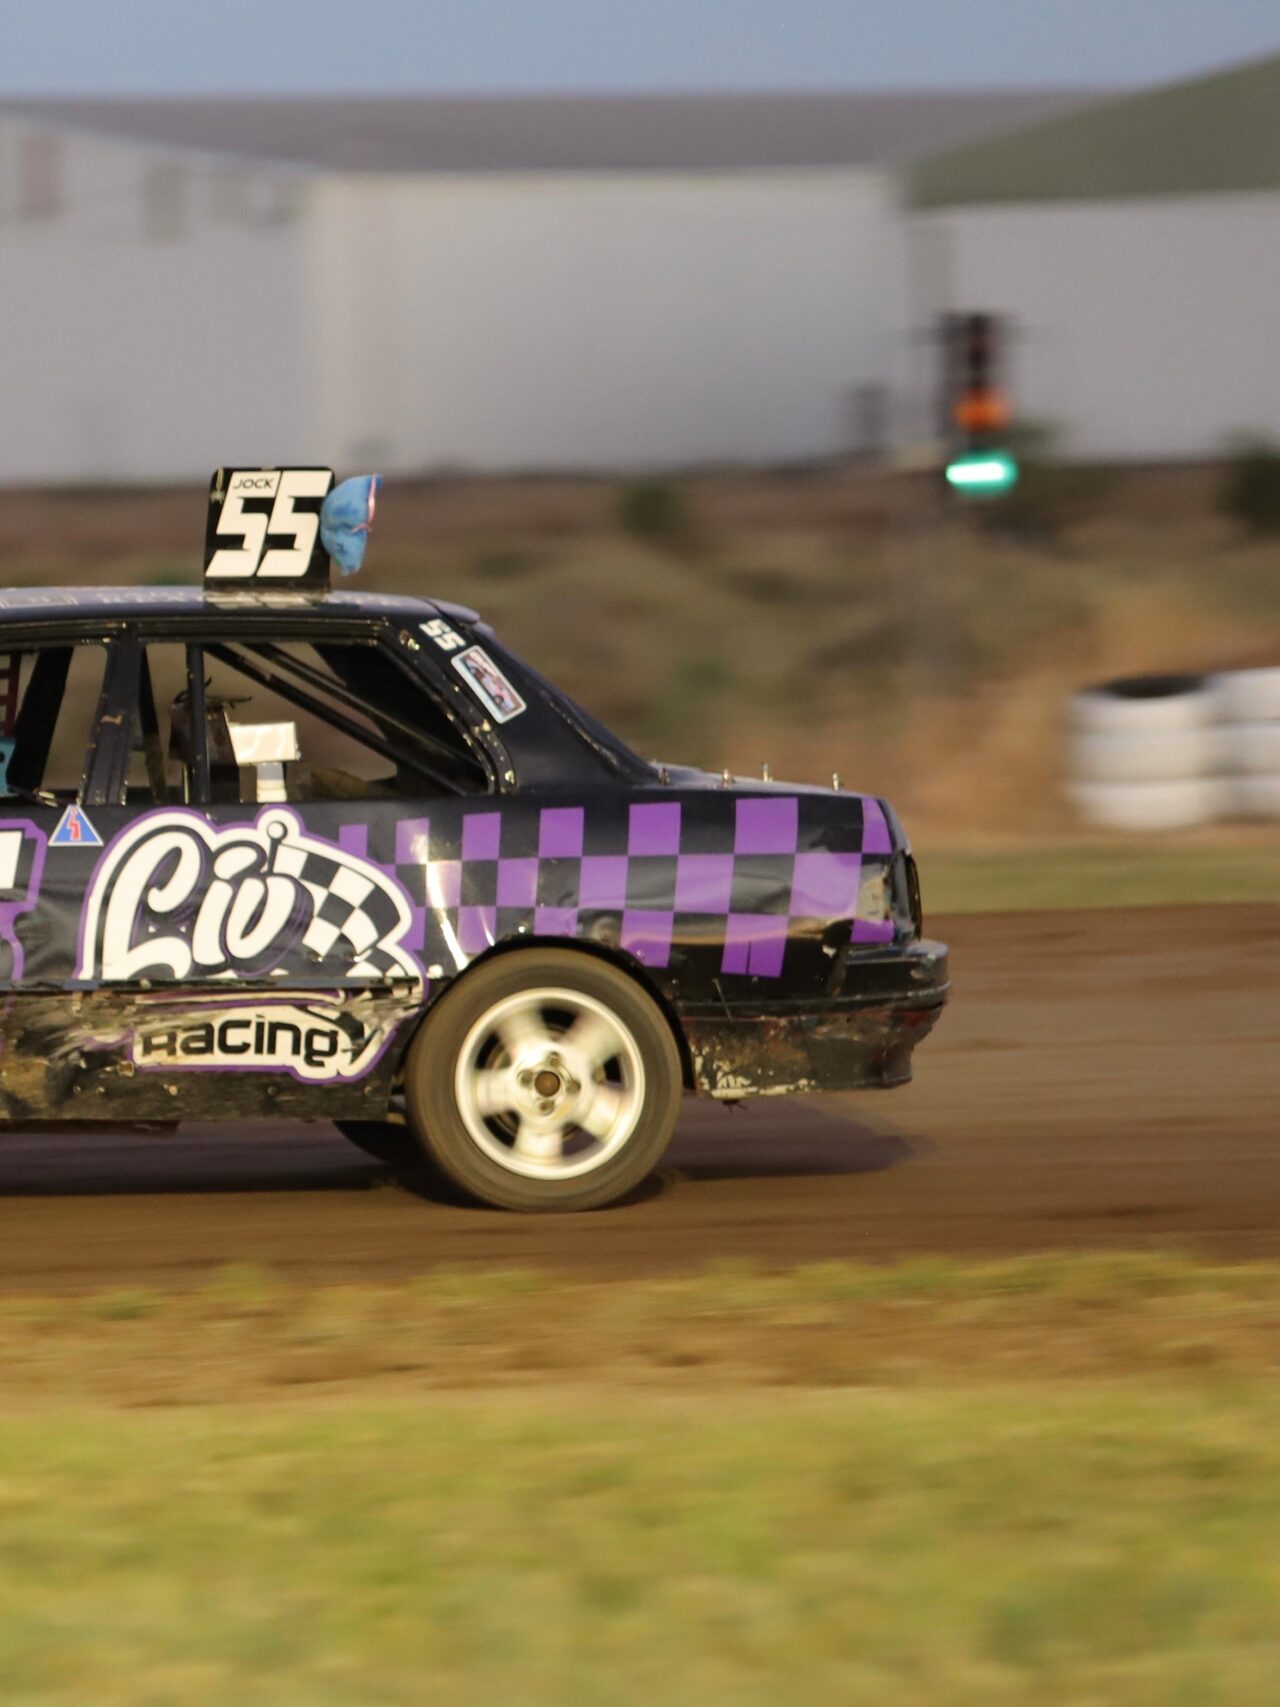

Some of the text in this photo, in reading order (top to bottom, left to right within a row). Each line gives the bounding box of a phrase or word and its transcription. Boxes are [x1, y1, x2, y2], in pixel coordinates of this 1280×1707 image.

[233, 478, 275, 490] JOCK
[205, 470, 333, 577] 55
[419, 618, 467, 651] 55
[140, 1013, 340, 1067] Racing
